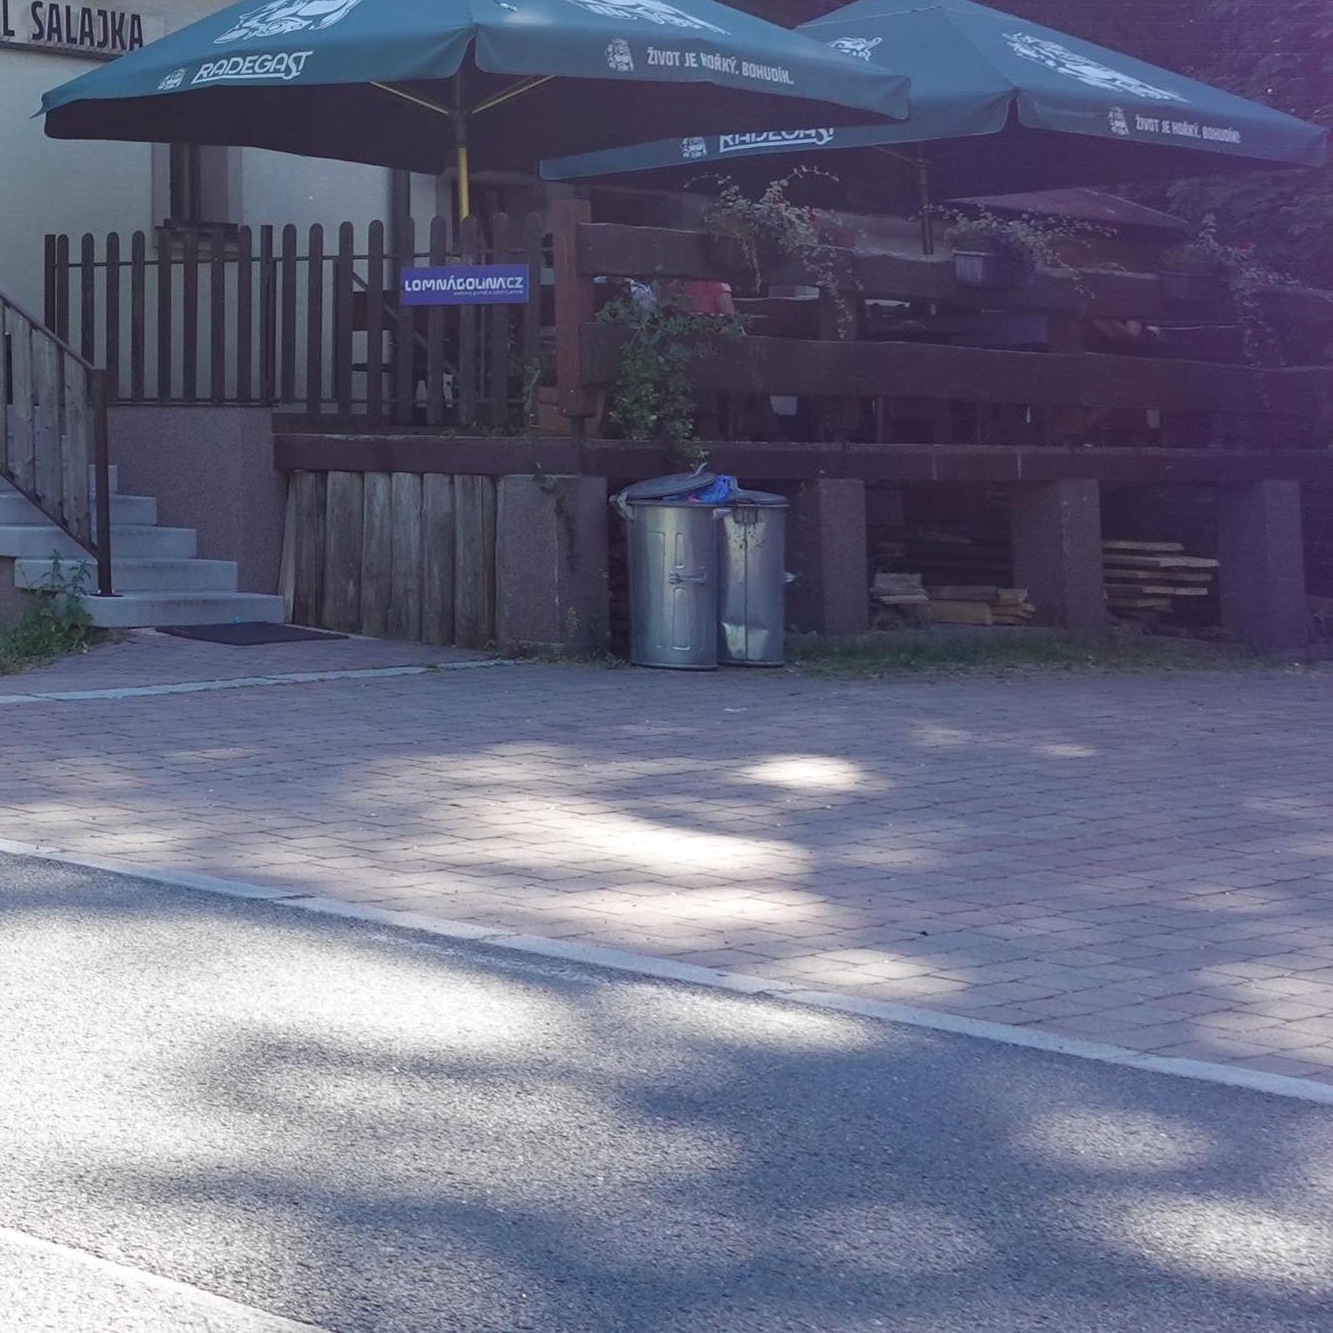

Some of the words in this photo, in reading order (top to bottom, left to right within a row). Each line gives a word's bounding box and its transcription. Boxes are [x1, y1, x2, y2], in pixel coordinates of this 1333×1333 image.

[30, 1, 144, 51] SALAJKA
[190, 51, 314, 85] RADEGAST
[647, 46, 681, 67] ŽIVOT
[684, 52, 699, 68] JE
[1161, 120, 1172, 134] JE
